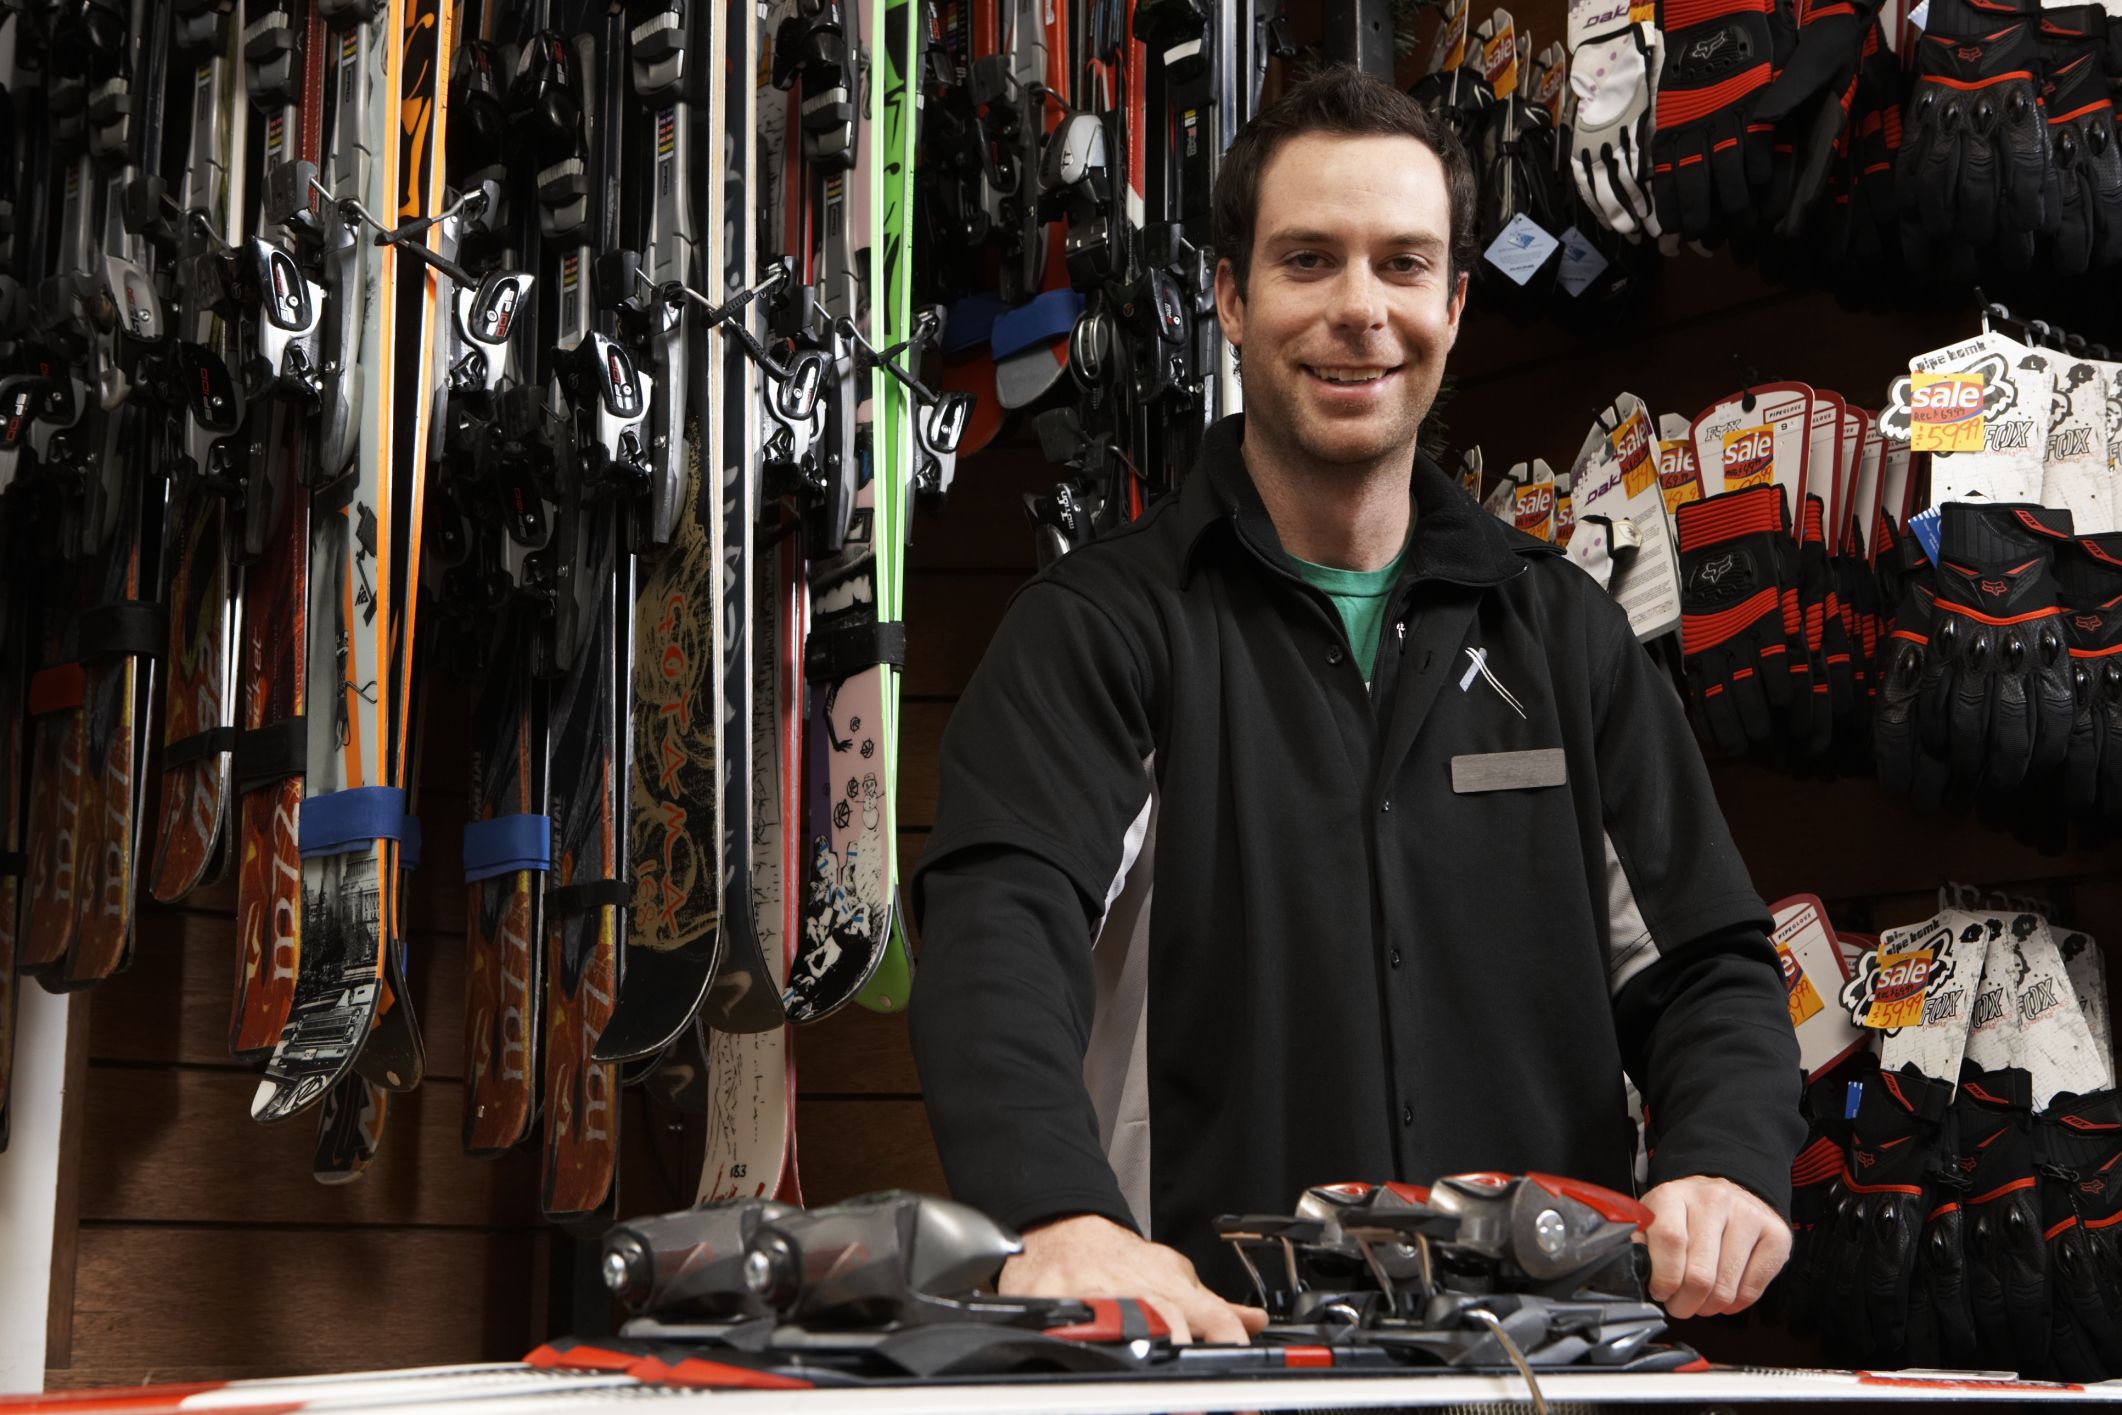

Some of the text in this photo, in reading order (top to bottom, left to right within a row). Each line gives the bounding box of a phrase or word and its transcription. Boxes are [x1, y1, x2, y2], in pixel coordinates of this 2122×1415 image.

[1486, 37, 1513, 74] sale
[496, 289, 515, 337] SP100
[1912, 381, 1980, 409] sale
[1617, 421, 1647, 462] sale
[1724, 431, 1772, 465] sale
[1984, 421, 2034, 451] FOX
[1660, 447, 1695, 476] ale
[1516, 488, 1550, 516] sale
[1778, 913, 1811, 940] PIPEGLOVE
[1877, 958, 1927, 989] sale
[1920, 989, 1964, 1026] FOX
[1973, 987, 2004, 1028] OX
